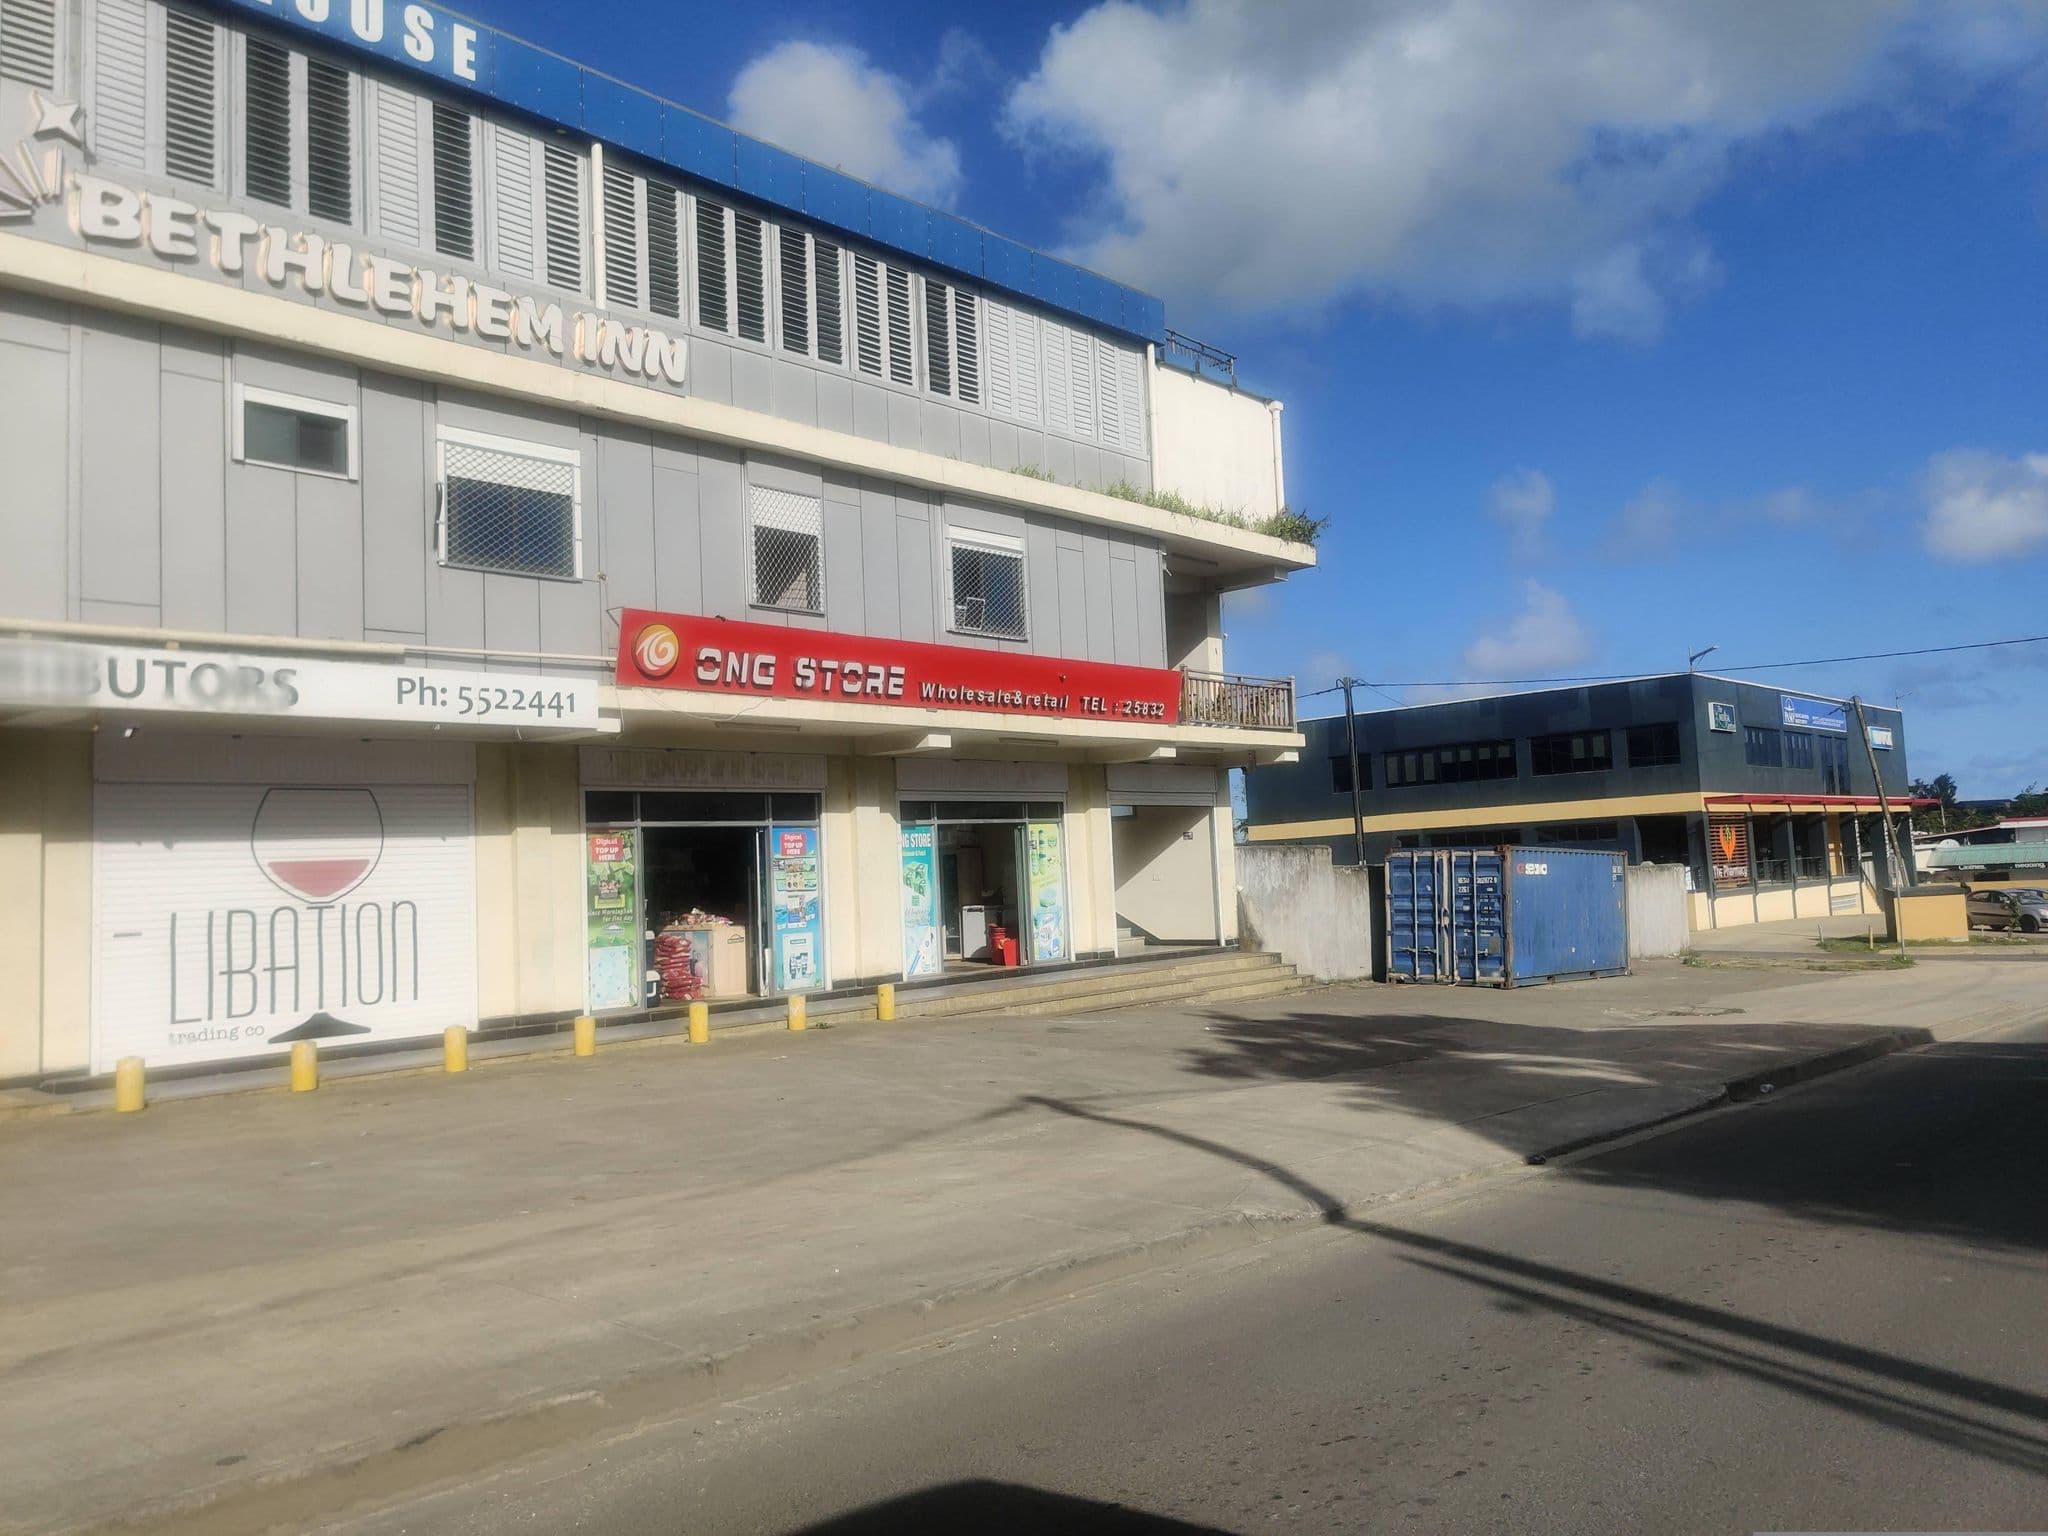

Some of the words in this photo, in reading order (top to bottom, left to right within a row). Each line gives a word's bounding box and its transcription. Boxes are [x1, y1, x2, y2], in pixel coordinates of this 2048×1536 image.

[252, 0, 477, 82] USE
[72, 171, 565, 354] BETHLEHEM
[574, 311, 687, 384] INN
[695, 647, 777, 687] ONG
[795, 656, 906, 696] STORE
[396, 677, 447, 708] Ph:
[458, 687, 576, 718] 5522441
[921, 682, 1069, 710] Wholesale&retail
[1082, 696, 1108, 712] TEL
[1125, 700, 1165, 717] 25832
[610, 846, 619, 854] UP
[910, 832, 931, 848] STORE
[169, 899, 418, 1025] LIBATION
[244, 1024, 265, 1036] co
